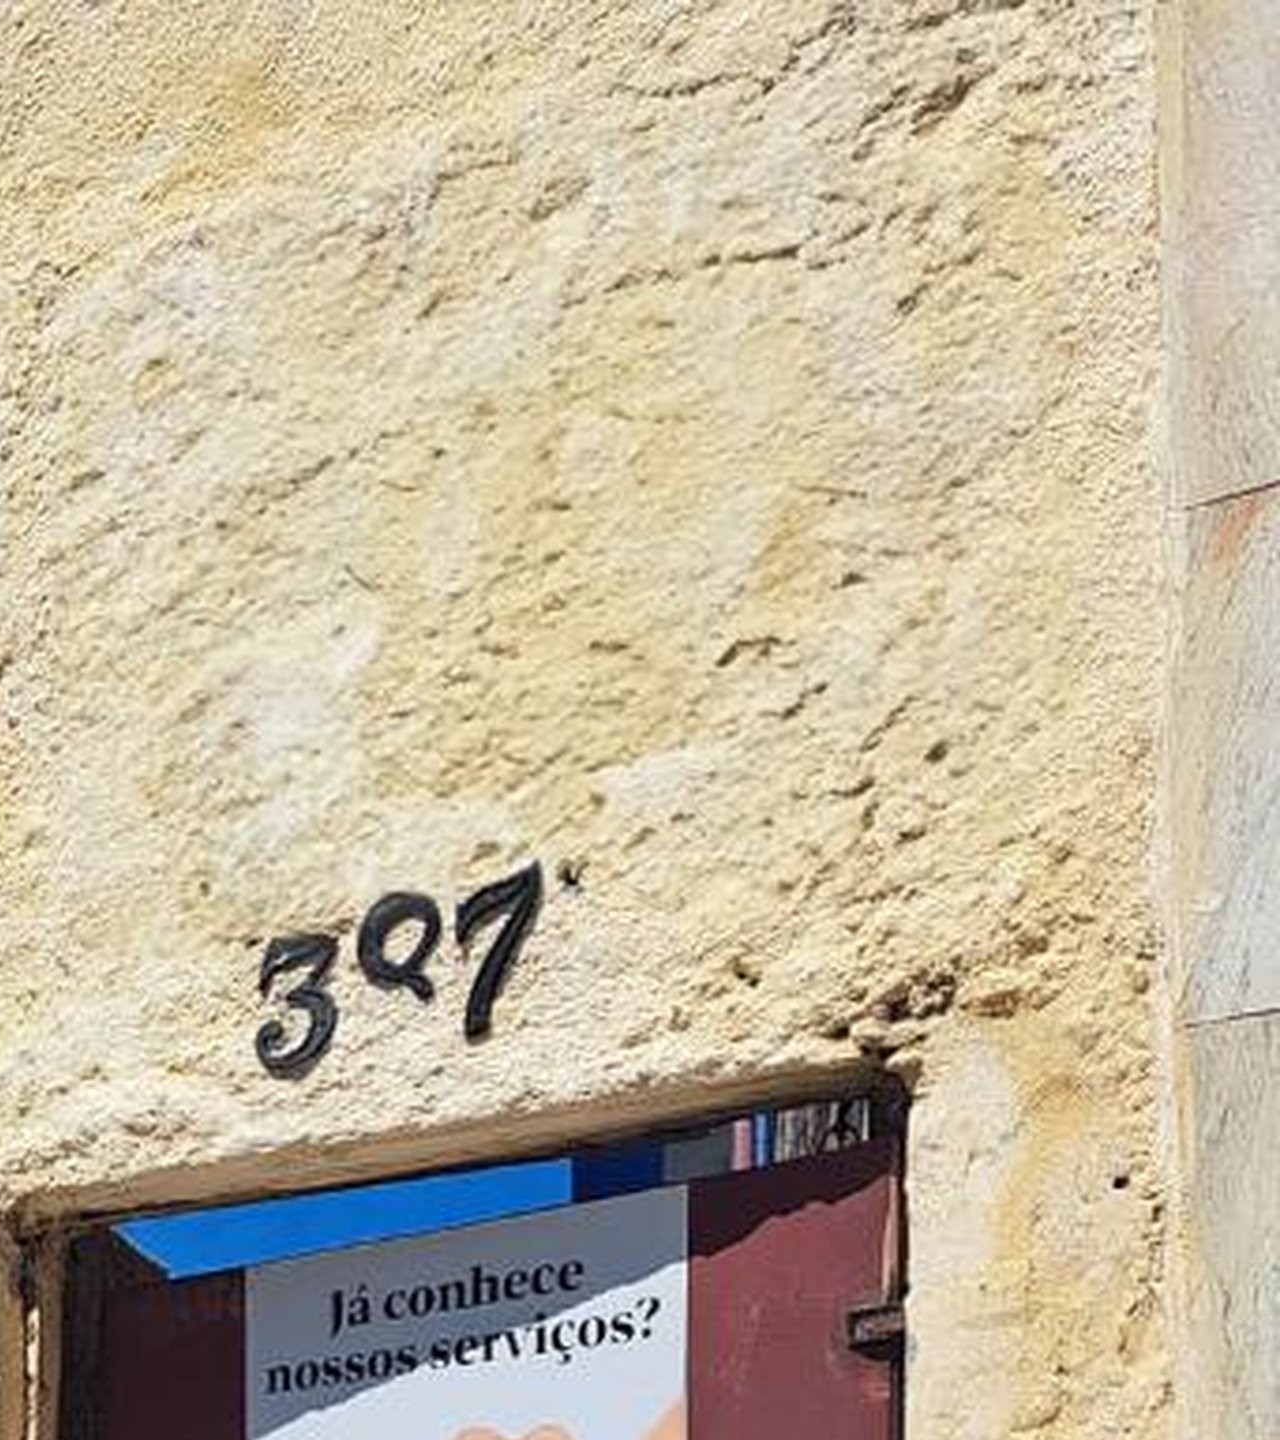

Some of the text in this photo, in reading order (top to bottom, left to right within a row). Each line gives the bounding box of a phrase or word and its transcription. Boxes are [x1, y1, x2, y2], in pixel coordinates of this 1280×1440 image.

[329, 1258, 586, 1338] Já conhece
[262, 1297, 661, 1393] nossos serviços?
